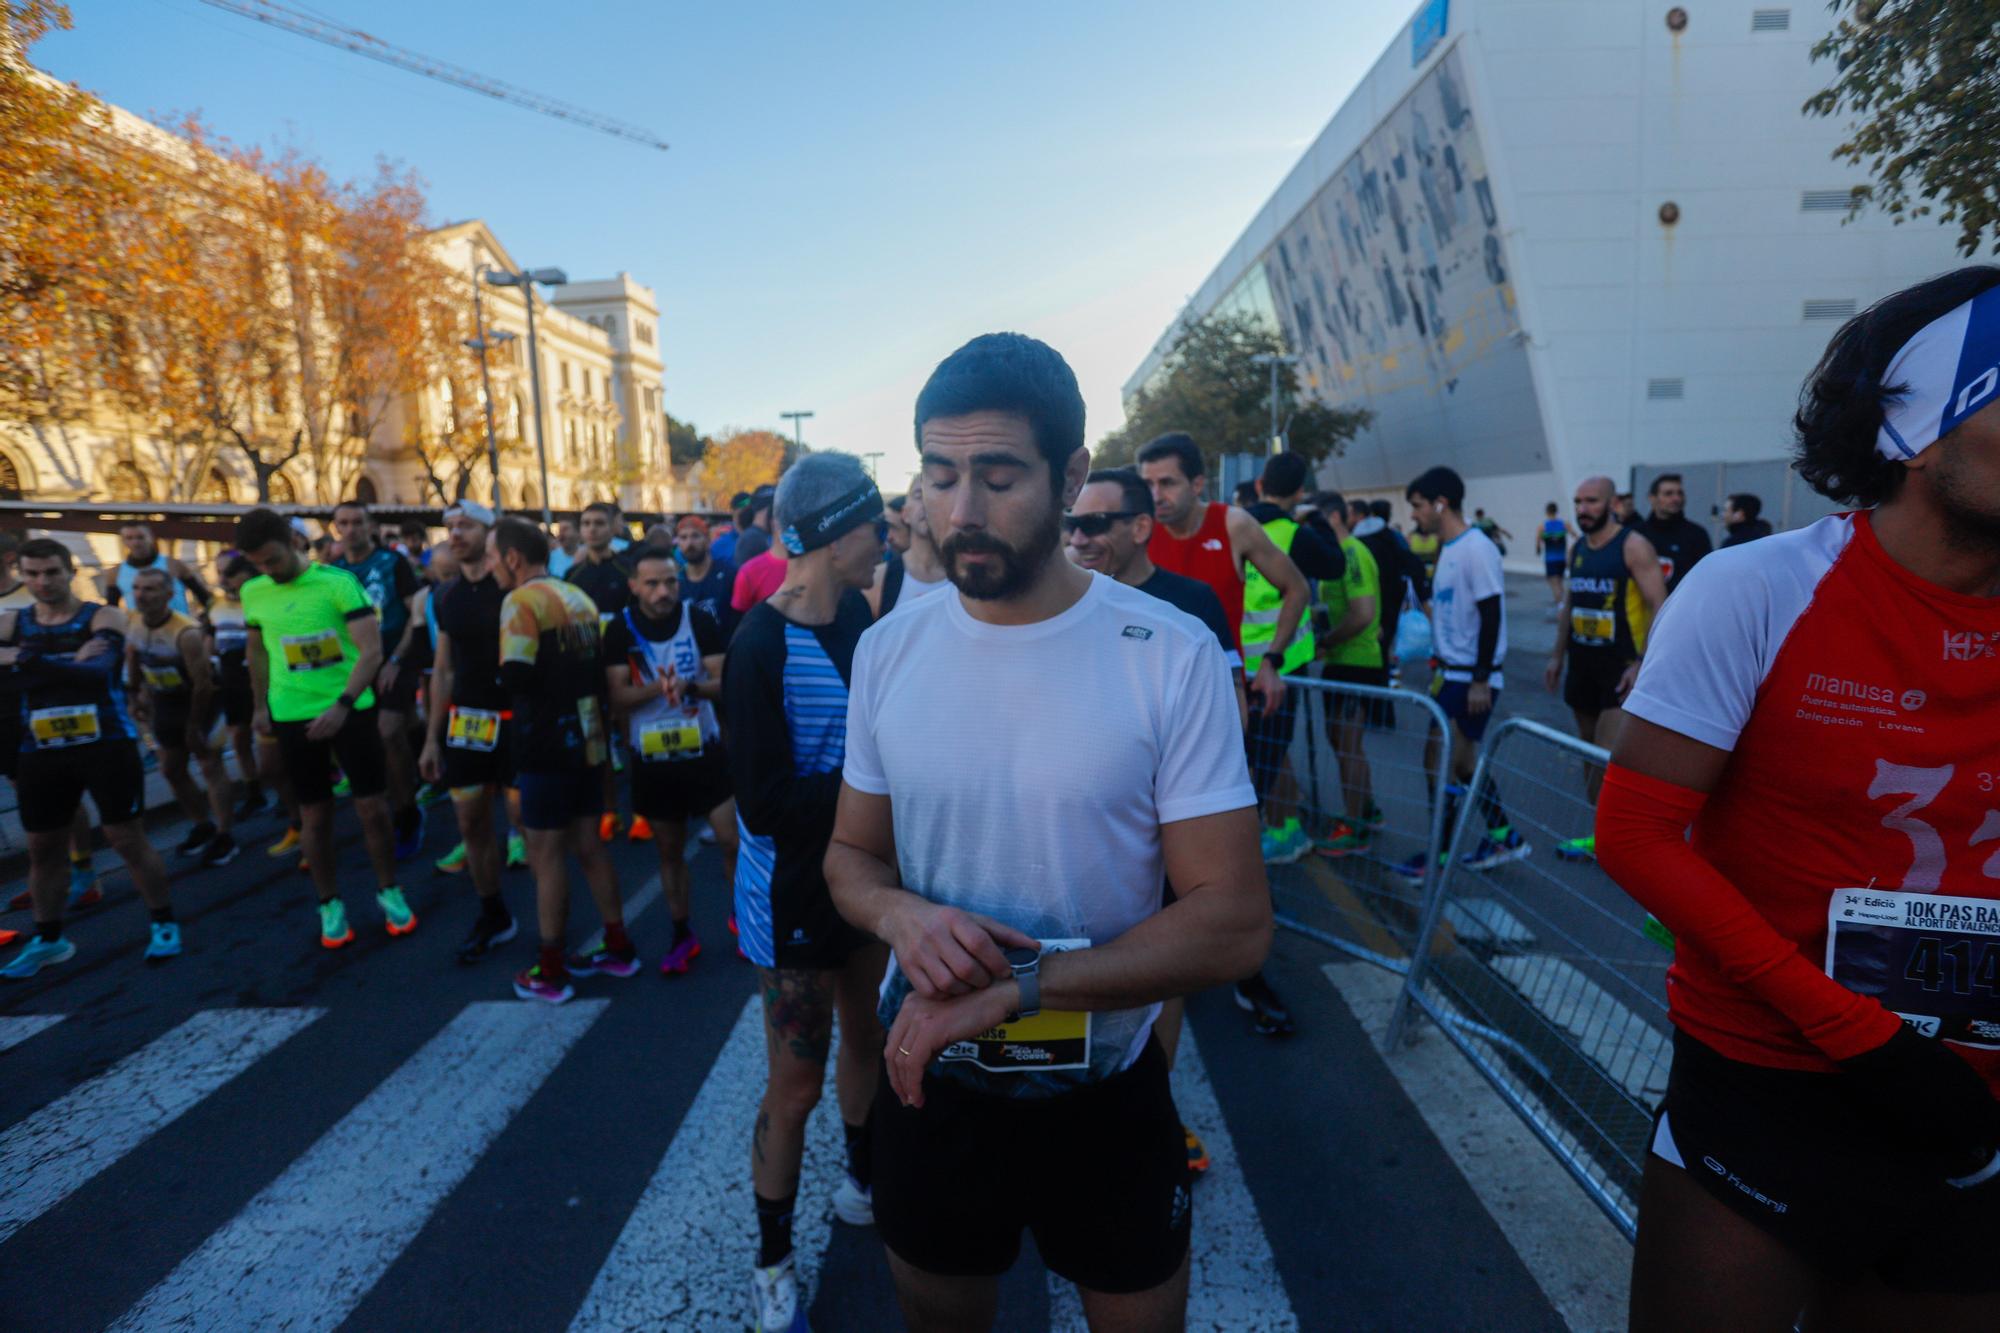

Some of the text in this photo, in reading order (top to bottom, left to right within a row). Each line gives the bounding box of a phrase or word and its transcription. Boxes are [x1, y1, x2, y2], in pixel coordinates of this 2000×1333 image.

[1806, 672, 1895, 704] manusa
[1801, 693, 1838, 710] Puertas
[1795, 709, 1925, 734] Delegación Levante
[1905, 901, 2000, 923] 10K PAS RA
[1905, 917, 1917, 926] AL
[1919, 917, 1945, 929] PORT
[1946, 919, 1959, 930] DE
[977, 1028, 1006, 1039] ose
